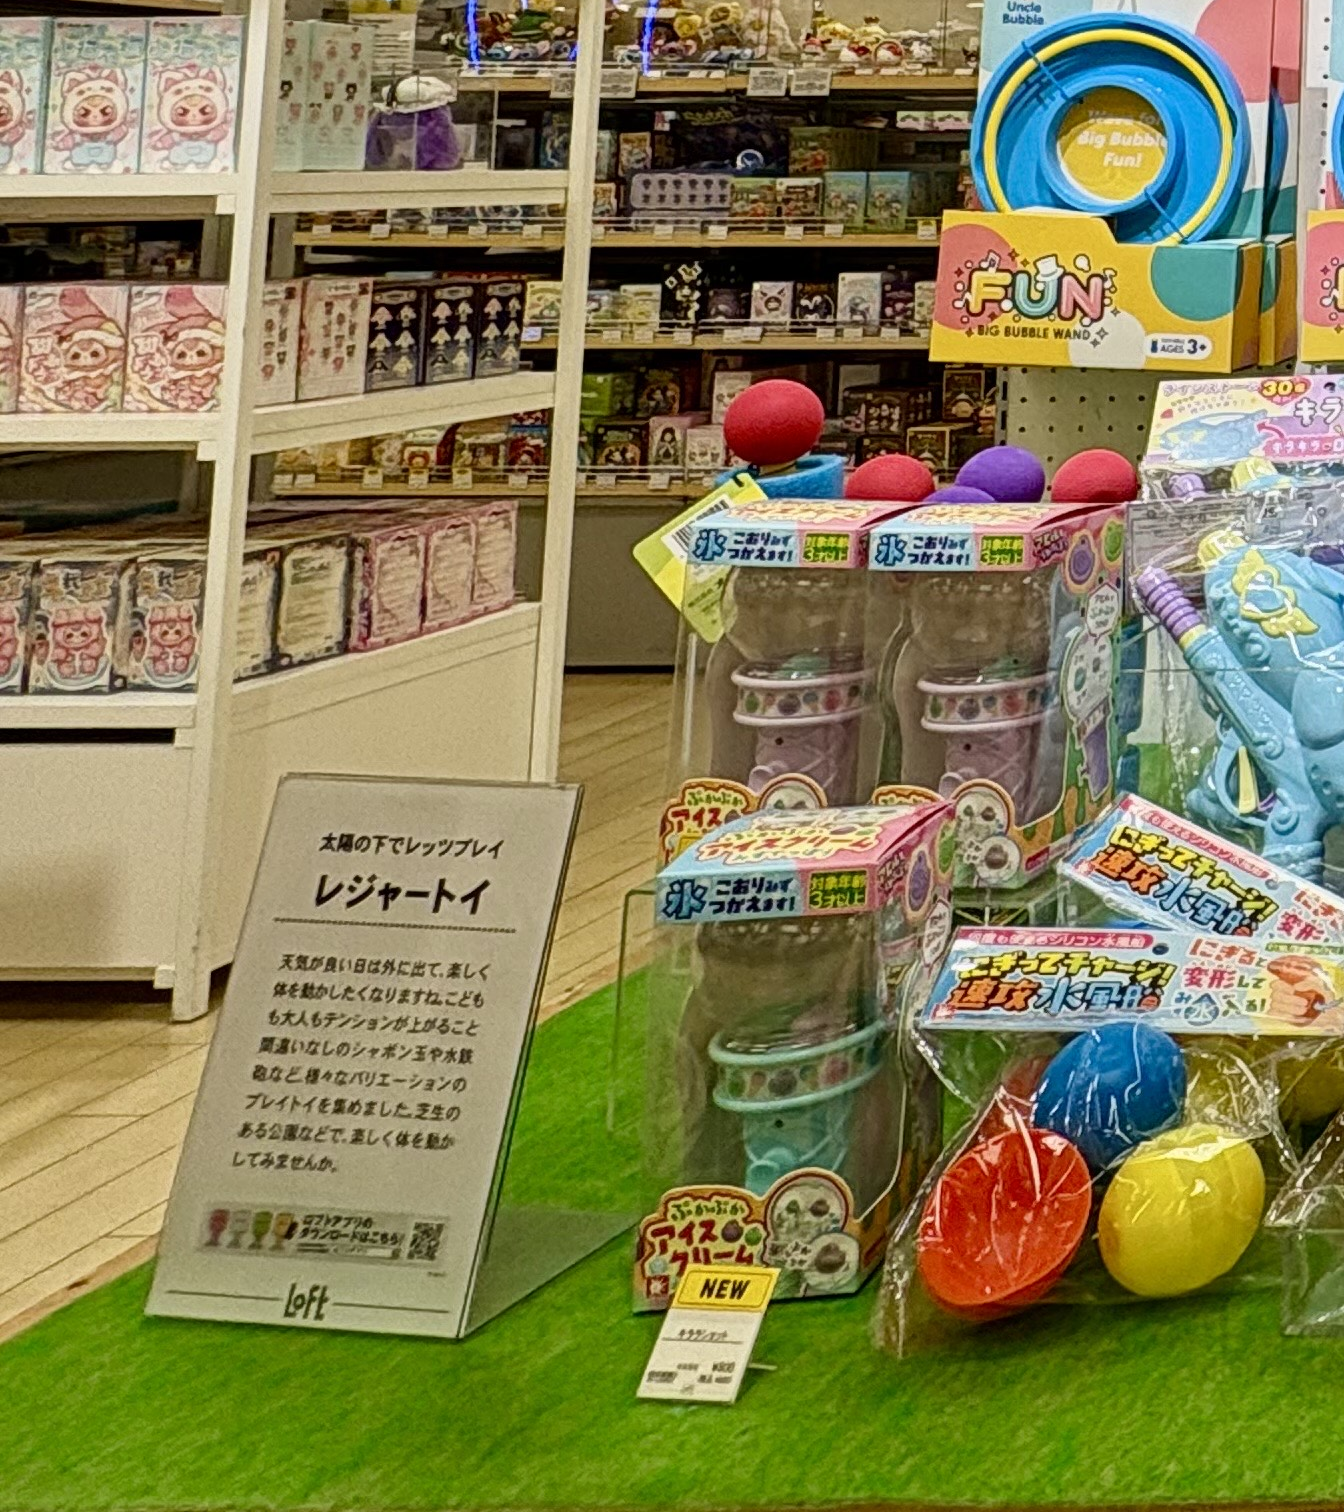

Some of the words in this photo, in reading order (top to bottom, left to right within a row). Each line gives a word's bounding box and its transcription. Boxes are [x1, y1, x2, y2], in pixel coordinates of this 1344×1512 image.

[1002, 14, 1045, 26] Bubble
[1007, 1, 1042, 14] Uncle
[1077, 131, 1105, 148] Big
[1103, 153, 1142, 169] Fun!
[966, 269, 1105, 321] FUN
[977, 324, 1000, 337] BIG
[1003, 325, 1050, 339] BUBBLE
[1053, 327, 1091, 341] WAND
[1160, 344, 1185, 354] AGES
[1187, 338, 1207, 354] 3+
[693, 528, 728, 561] 氷
[877, 531, 909, 566] 氷
[319, 832, 504, 860] 太陽の下でレッツプレイ
[1108, 825, 1280, 922] にぎってチャージ!
[315, 874, 491, 915] レジャートイ
[663, 878, 708, 920] 氷
[957, 949, 1177, 988] にぎってチャージ!
[268, 1009, 480, 1037] も大人もテンションが上がること
[232, 1151, 338, 1173] してみませんか。
[651, 1219, 718, 1254] アイス
[670, 1245, 754, 1277] クリーム
[284, 1283, 329, 1320] Loft
[700, 1278, 752, 1300] NEW
